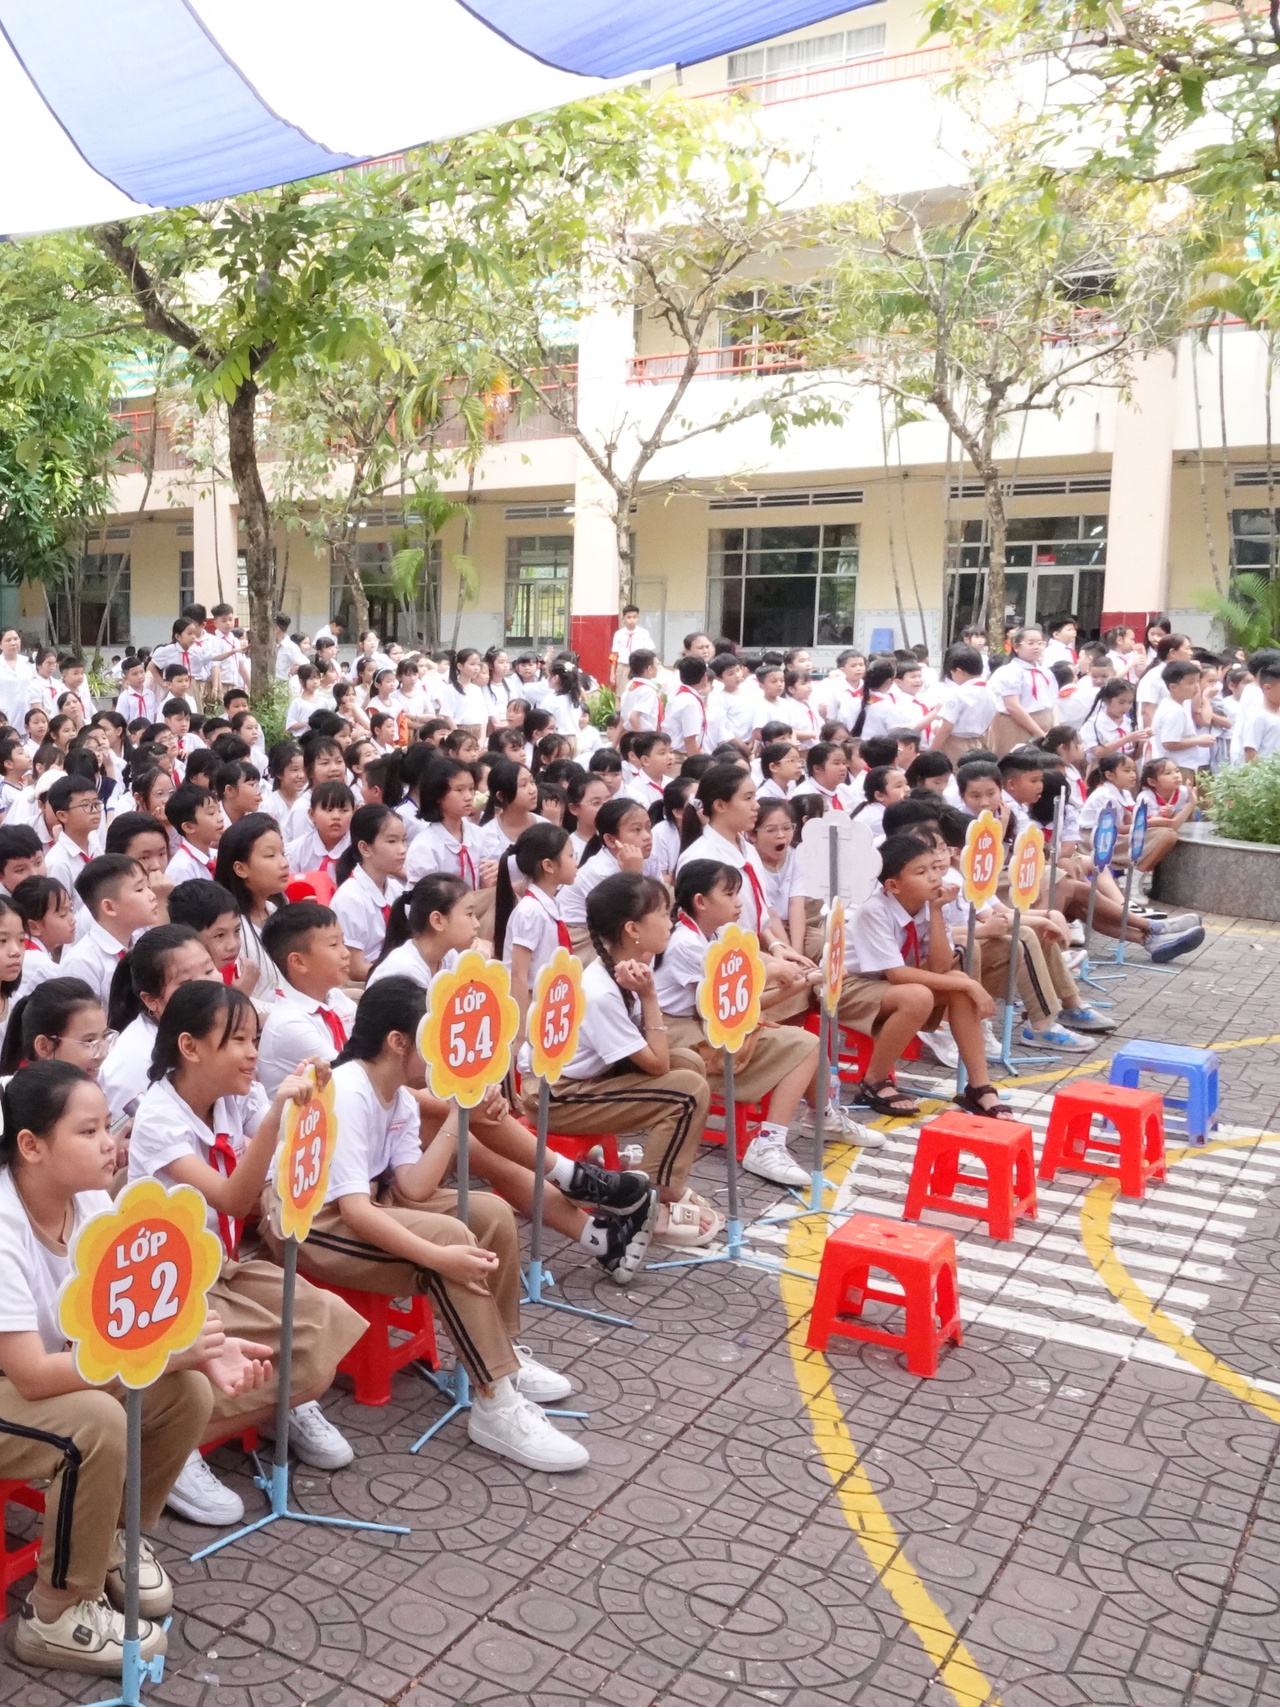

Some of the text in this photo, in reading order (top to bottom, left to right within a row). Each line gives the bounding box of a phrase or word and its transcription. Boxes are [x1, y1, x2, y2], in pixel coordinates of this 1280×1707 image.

[973, 853, 993, 882] 5.9
[1018, 861, 1036, 889] 5.10
[721, 950, 743, 979] LỚP
[454, 988, 488, 1015] LỚP
[548, 976, 569, 1004] LỚP
[717, 977, 749, 1022] 5.6
[448, 1020, 494, 1067] 5.4
[543, 1005, 570, 1046] 5.5
[299, 1106, 322, 1138] LỚP
[292, 1137, 322, 1199] 5.3
[115, 1225, 168, 1270] LỚP
[106, 1260, 180, 1340] 5.2
